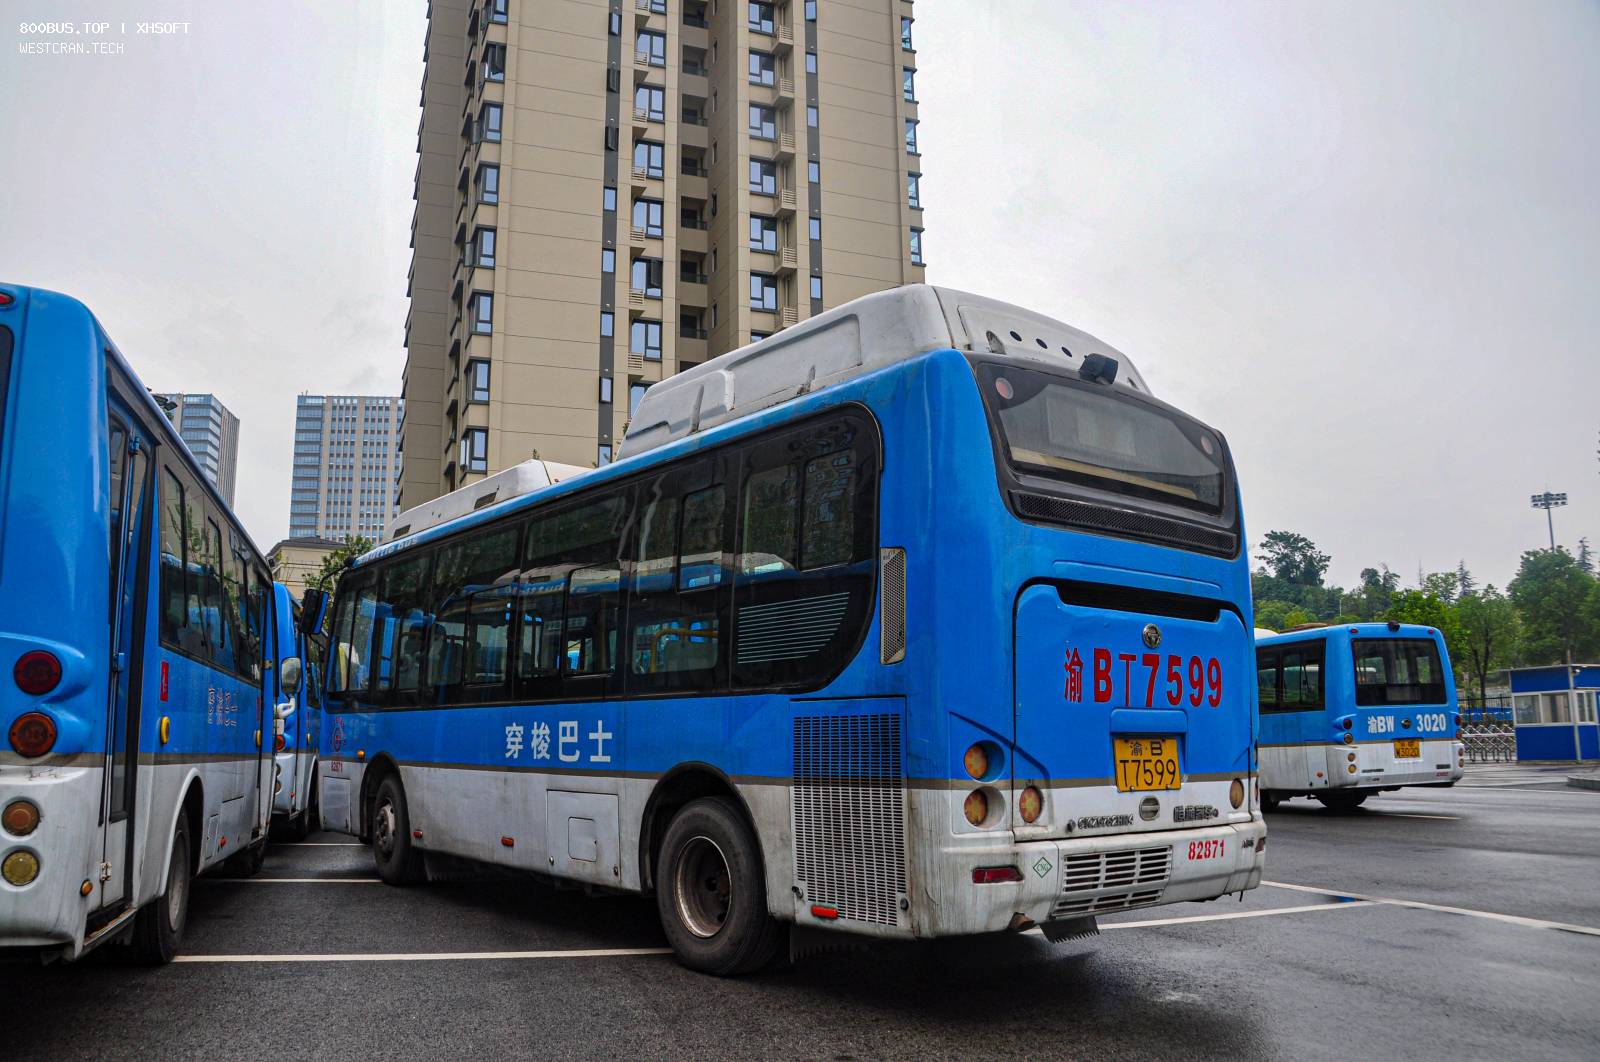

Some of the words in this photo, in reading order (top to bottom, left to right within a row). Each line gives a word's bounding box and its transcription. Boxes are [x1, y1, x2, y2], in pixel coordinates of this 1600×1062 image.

[1064, 647, 1222, 708] 渝BT7599
[1367, 715, 1395, 734] 渝BW
[1416, 713, 1447, 732] 3020
[504, 719, 613, 763] 穿梭巴士
[1119, 759, 1177, 787] T7599
[1188, 839, 1225, 860] 82871
